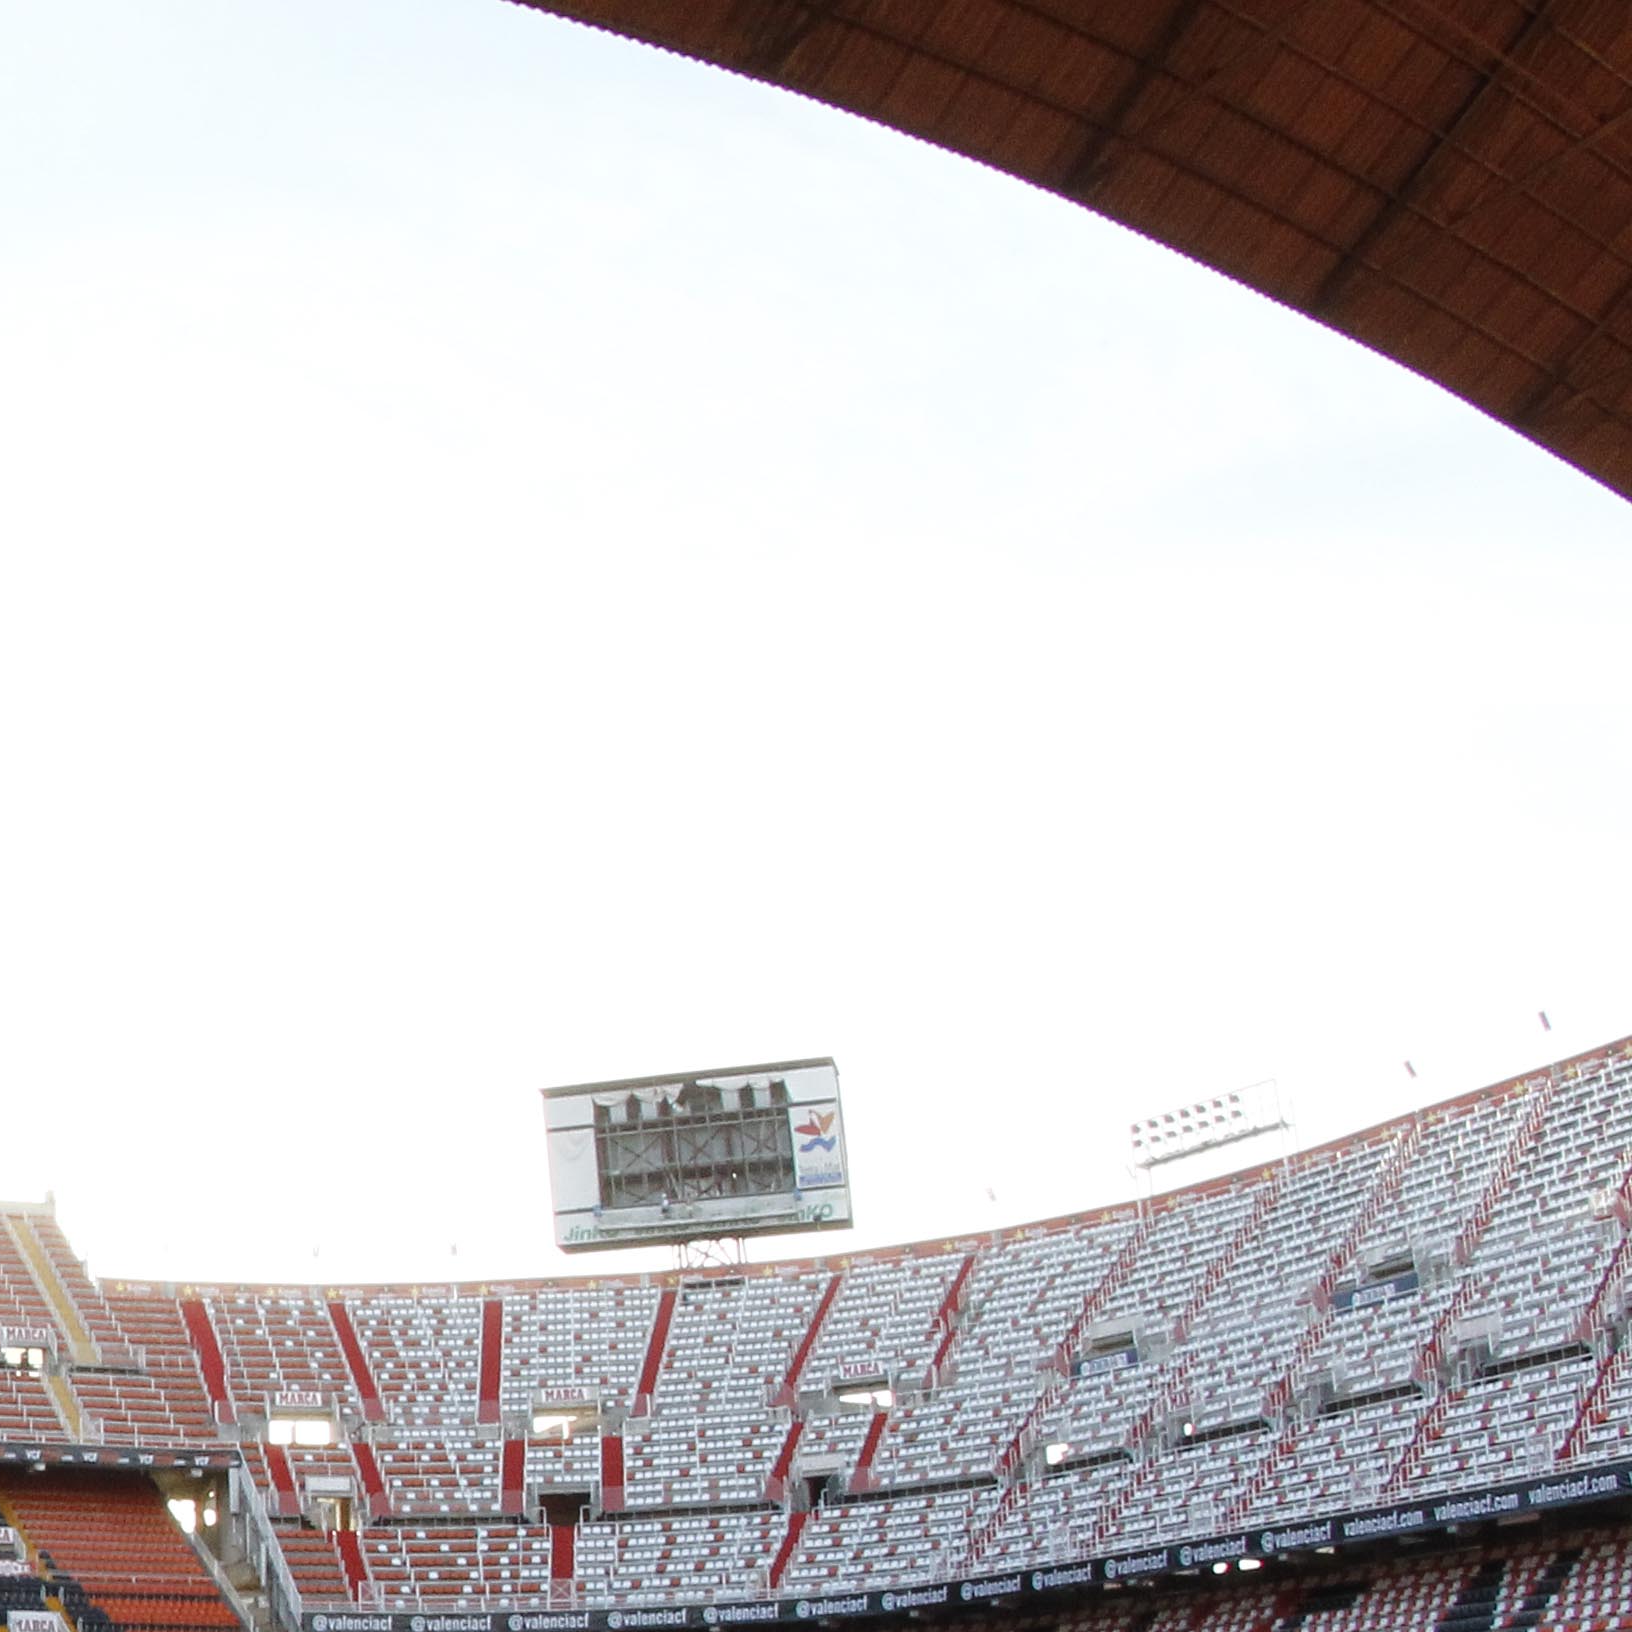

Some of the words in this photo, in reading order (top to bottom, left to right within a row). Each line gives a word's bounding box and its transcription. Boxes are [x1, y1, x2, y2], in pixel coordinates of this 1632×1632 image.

[843, 1362, 882, 1378] MARCA
[545, 1388, 584, 1400] MARCA
[1529, 1472, 1618, 1504] valenciacf.com
[1433, 1493, 1519, 1521] valenciacf.com
[1344, 1509, 1424, 1536] valenciacf.com
[1261, 1521, 1332, 1552] @valenciacf
[1179, 1536, 1246, 1566] @valenciacf
[1104, 1551, 1167, 1578] @valenciacf
[960, 1575, 1021, 1600] @valenciacf
[1032, 1564, 1091, 1590] @valenciacf
[796, 1595, 868, 1618] @valenciacf
[881, 1586, 947, 1610] @valenciacf
[312, 1613, 392, 1632] @valenciacf
[410, 1614, 492, 1632] @valenciacf
[508, 1612, 589, 1631] @valenciacf
[608, 1608, 687, 1629] @valenciacf
[703, 1603, 779, 1624] @valenciacf
